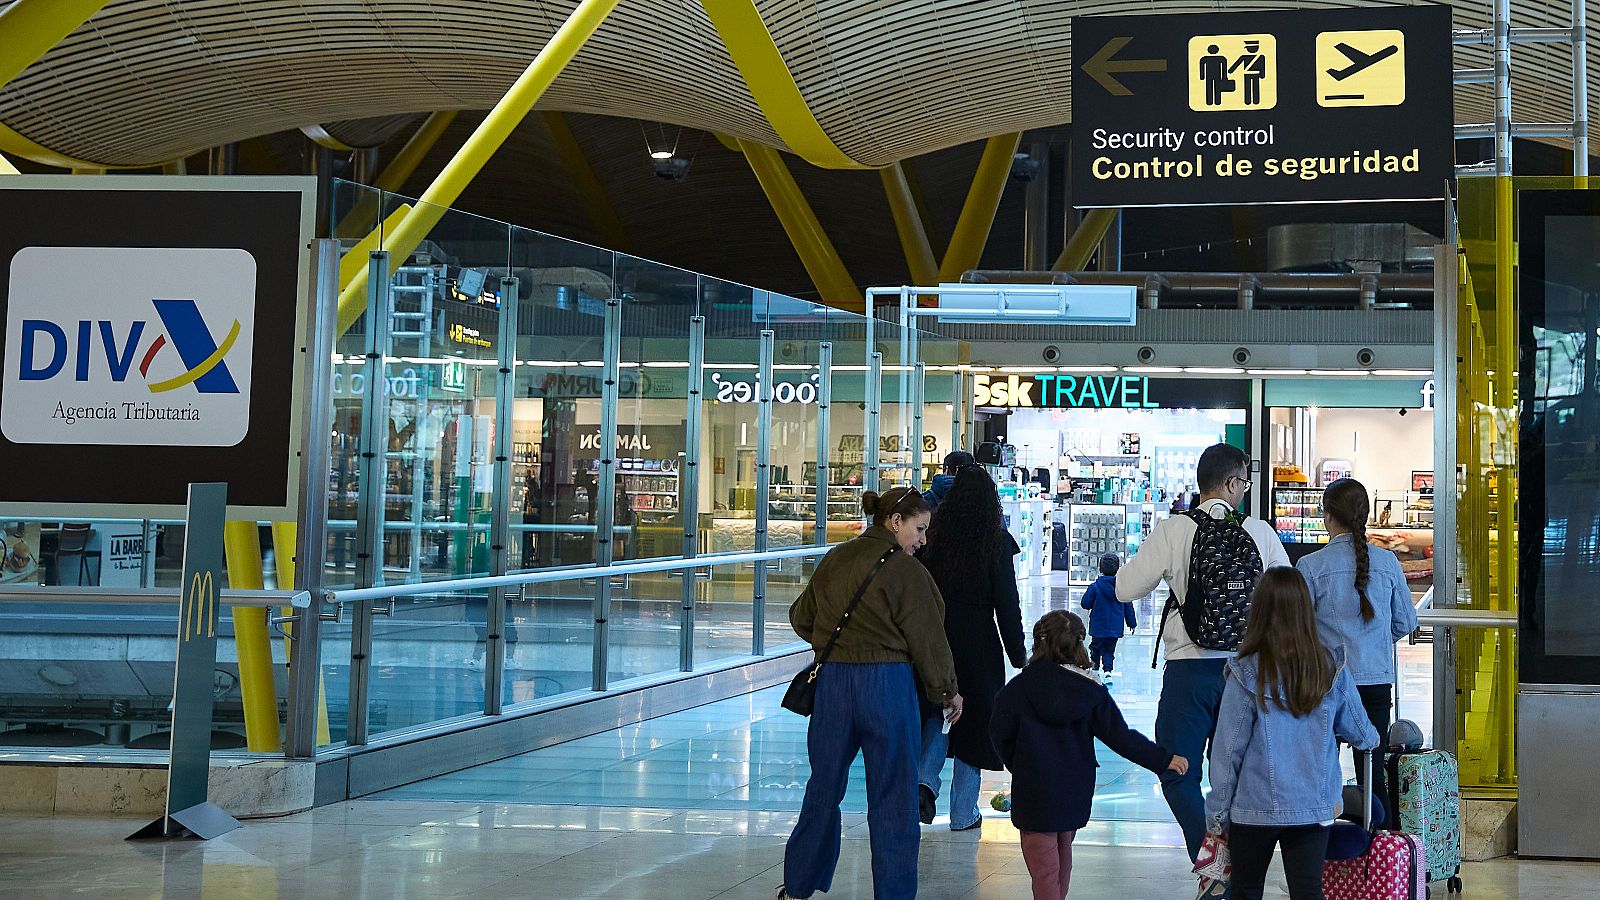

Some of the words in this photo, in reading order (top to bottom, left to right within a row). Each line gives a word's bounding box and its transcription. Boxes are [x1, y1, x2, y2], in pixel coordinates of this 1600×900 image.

[1091, 127, 1185, 152] Security
[1193, 125, 1275, 147] control
[1091, 155, 1203, 180] Control
[1214, 154, 1253, 178] de
[1263, 149, 1420, 181] seguridad
[1034, 374, 1160, 407] TRAVEL
[52, 400, 117, 425] Agencia
[122, 401, 201, 421] Tributaria
[110, 539, 121, 555] LA
